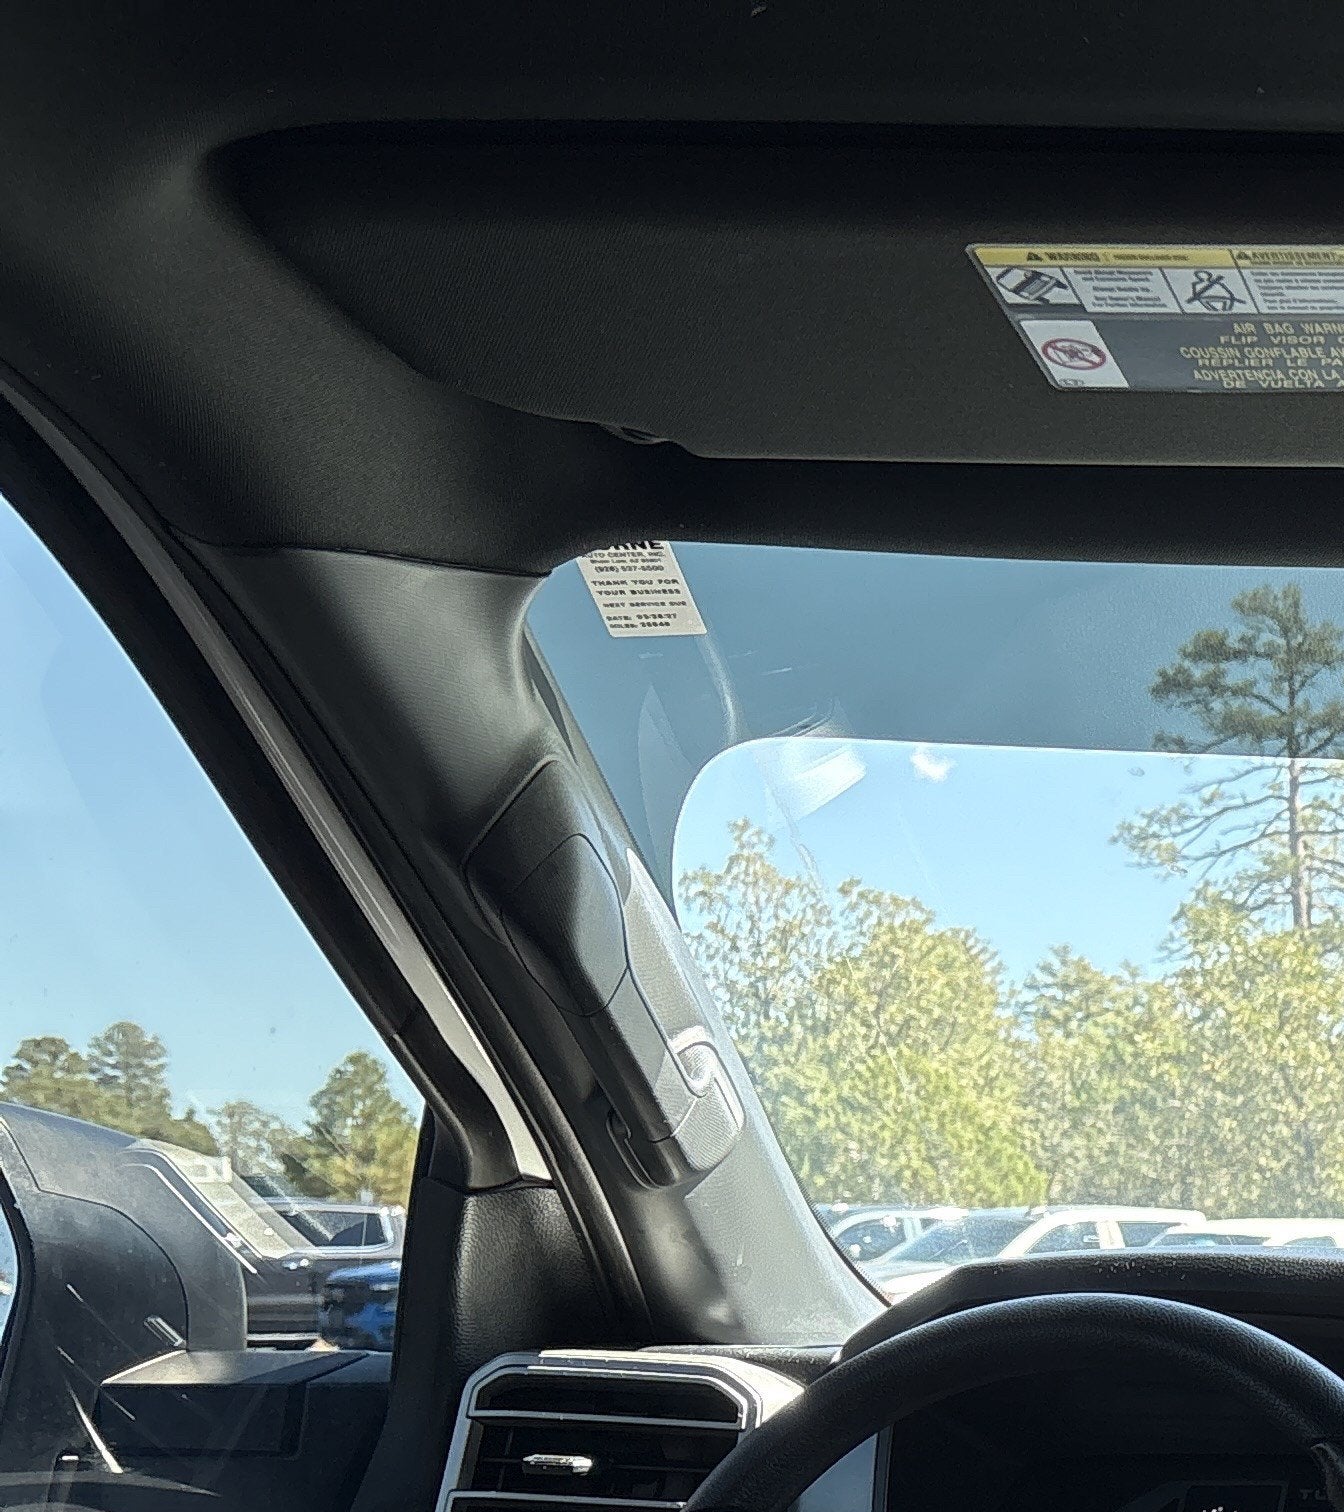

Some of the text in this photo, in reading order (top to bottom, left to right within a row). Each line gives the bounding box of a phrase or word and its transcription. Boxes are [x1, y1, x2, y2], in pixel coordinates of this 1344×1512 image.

[1233, 323, 1257, 334] AIR
[1263, 323, 1294, 335] BAG
[1219, 335, 1258, 344] FLIP
[1270, 335, 1326, 344] VISOR
[1180, 346, 1241, 359] COUSSIN
[1243, 346, 1325, 358] GONFLABLE
[1198, 358, 1274, 367] REPLIER
[1286, 358, 1308, 367] LE
[1194, 369, 1284, 381] ADVERTENCIA
[1288, 369, 1318, 380] CON
[1323, 369, 1339, 380] LA
[1259, 380, 1326, 389] VUELTA
